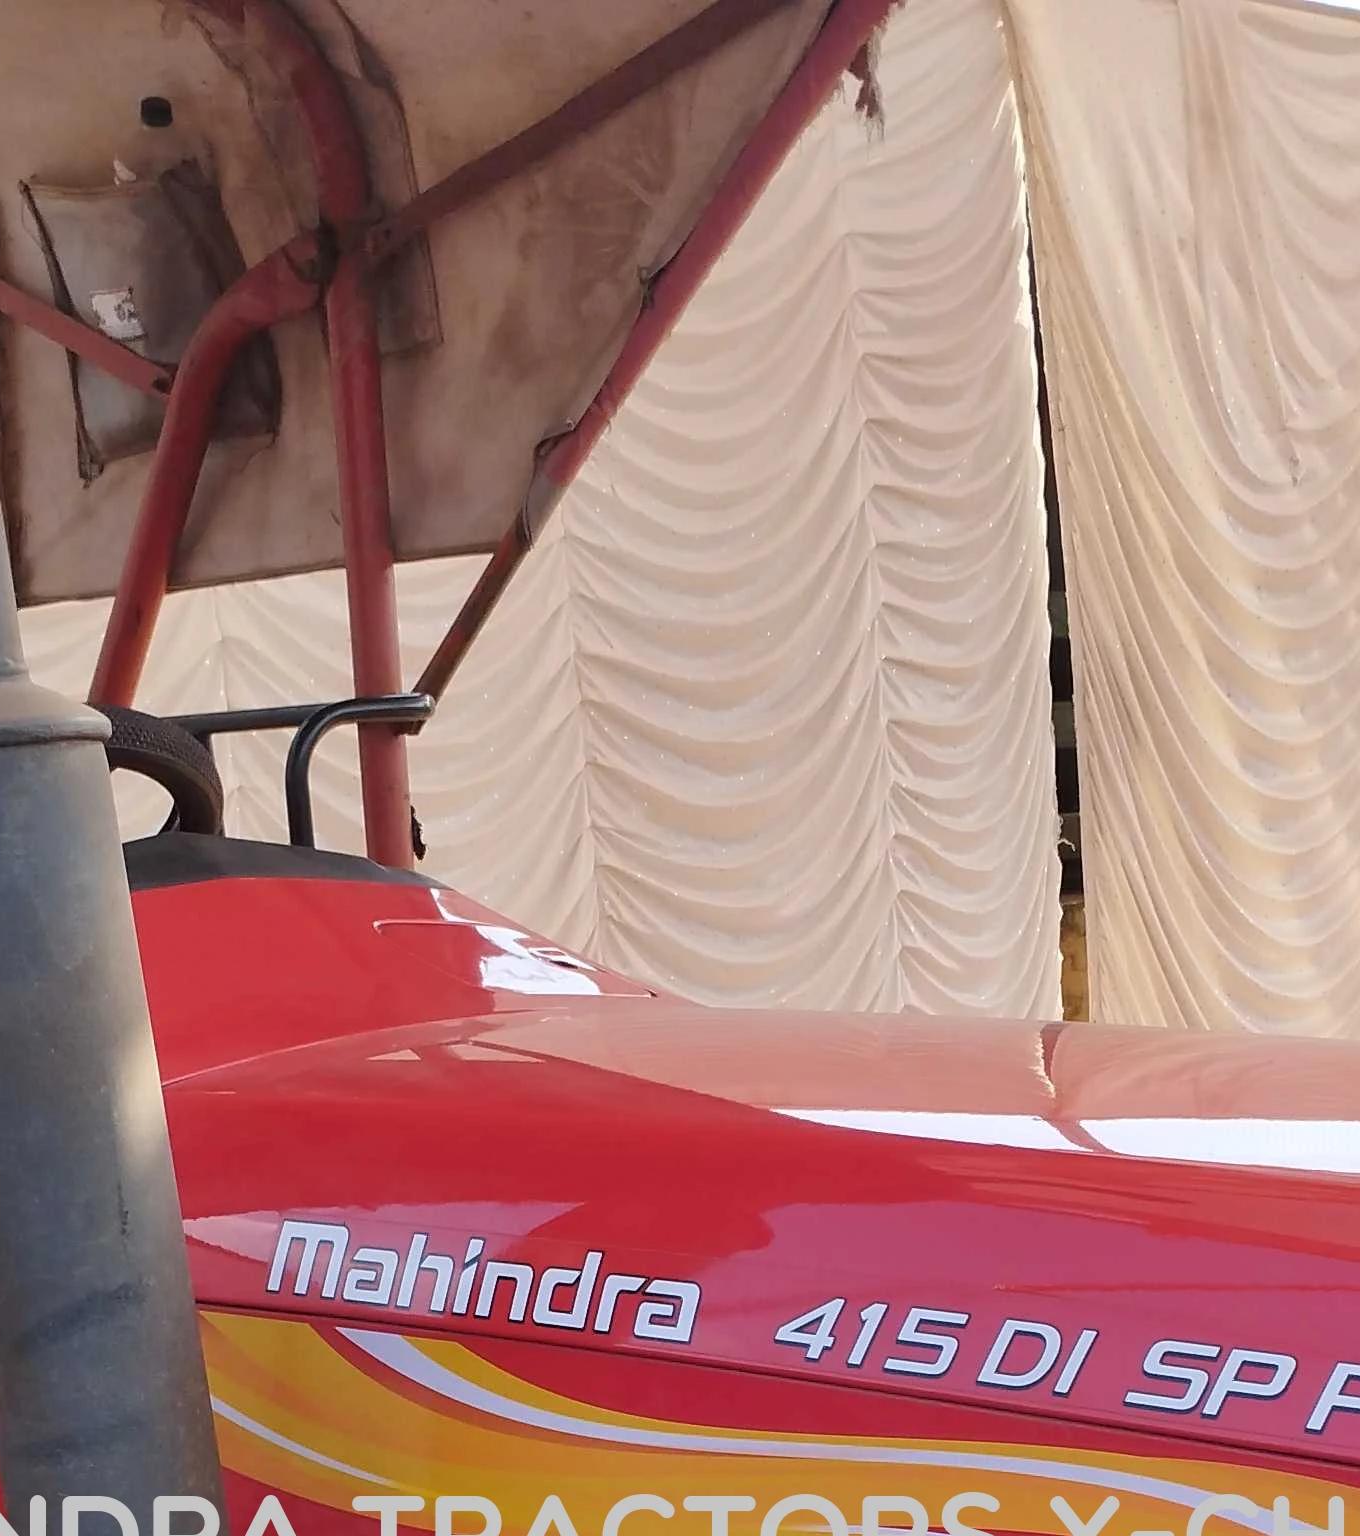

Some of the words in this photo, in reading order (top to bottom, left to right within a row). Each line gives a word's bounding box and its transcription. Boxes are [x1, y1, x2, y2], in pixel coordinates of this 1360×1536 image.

[265, 1218, 702, 1344] Mahindra
[772, 1297, 971, 1377] 415
[975, 1318, 1099, 1396] DI
[1121, 1339, 1299, 1417] SP
